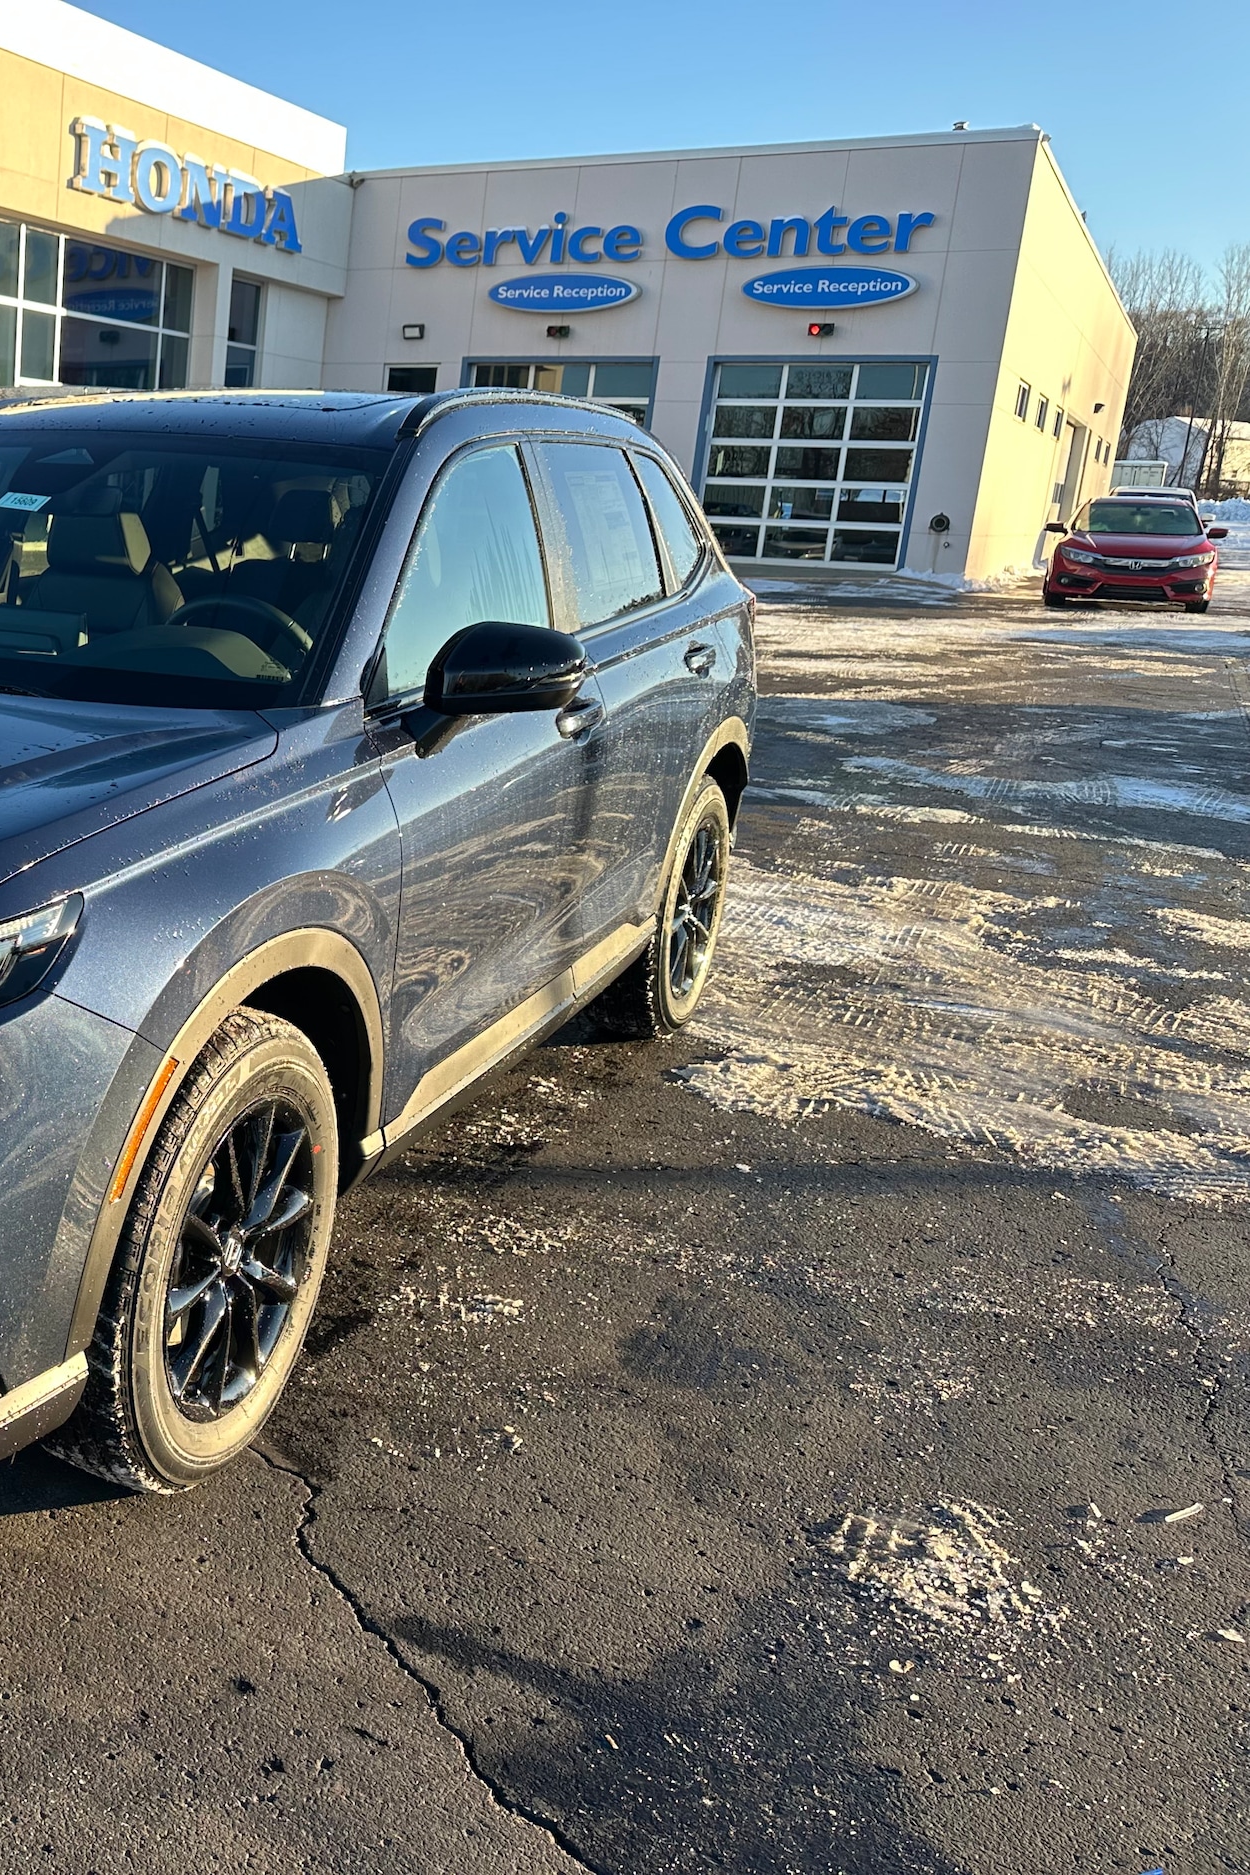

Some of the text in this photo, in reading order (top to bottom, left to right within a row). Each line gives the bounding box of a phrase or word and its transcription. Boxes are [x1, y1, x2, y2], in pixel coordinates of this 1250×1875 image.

[70, 118, 302, 253] HONDA
[406, 205, 935, 267] Service Center
[498, 284, 626, 300] Service Reception
[753, 278, 902, 295] Service Reception
